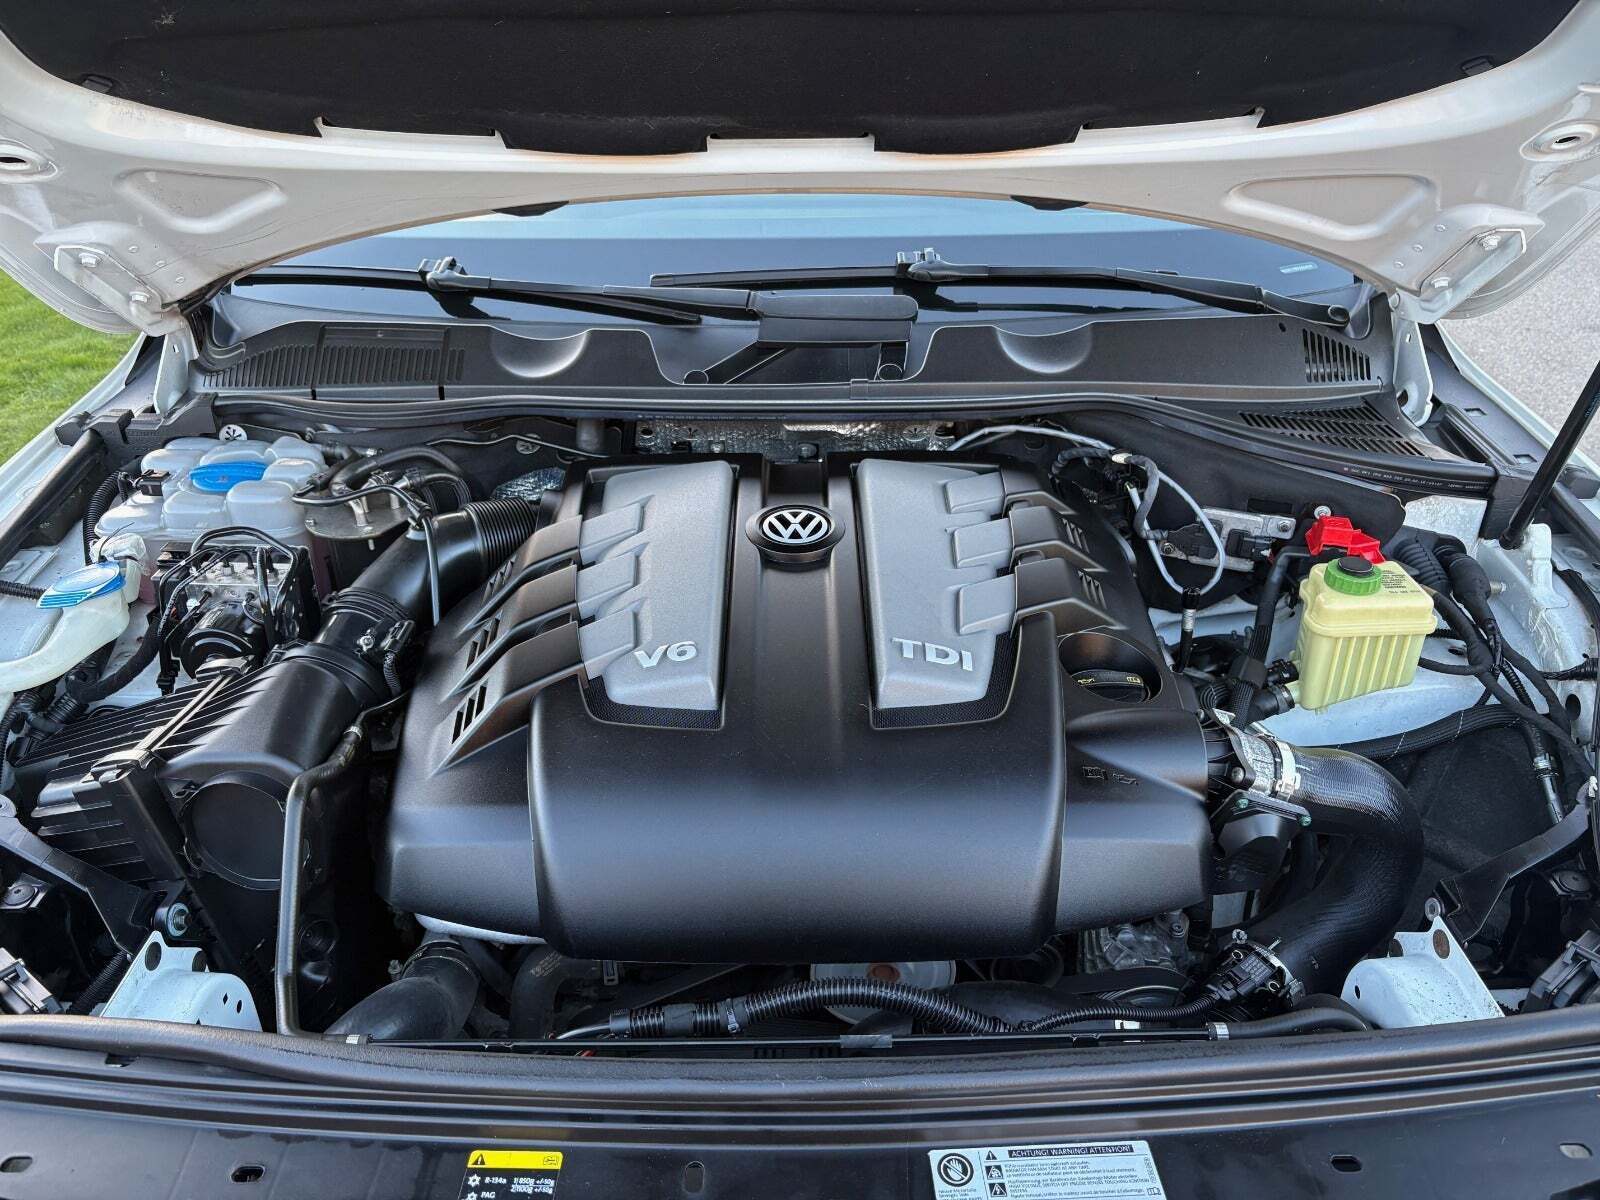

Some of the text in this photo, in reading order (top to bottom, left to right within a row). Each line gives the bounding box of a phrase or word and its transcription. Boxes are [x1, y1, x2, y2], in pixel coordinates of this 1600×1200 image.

[763, 510, 829, 545] VW
[634, 639, 698, 670] V6
[891, 637, 974, 671] TDI
[1011, 1145, 1132, 1158] ACHTUNG! WARNING! ATTENTION!
